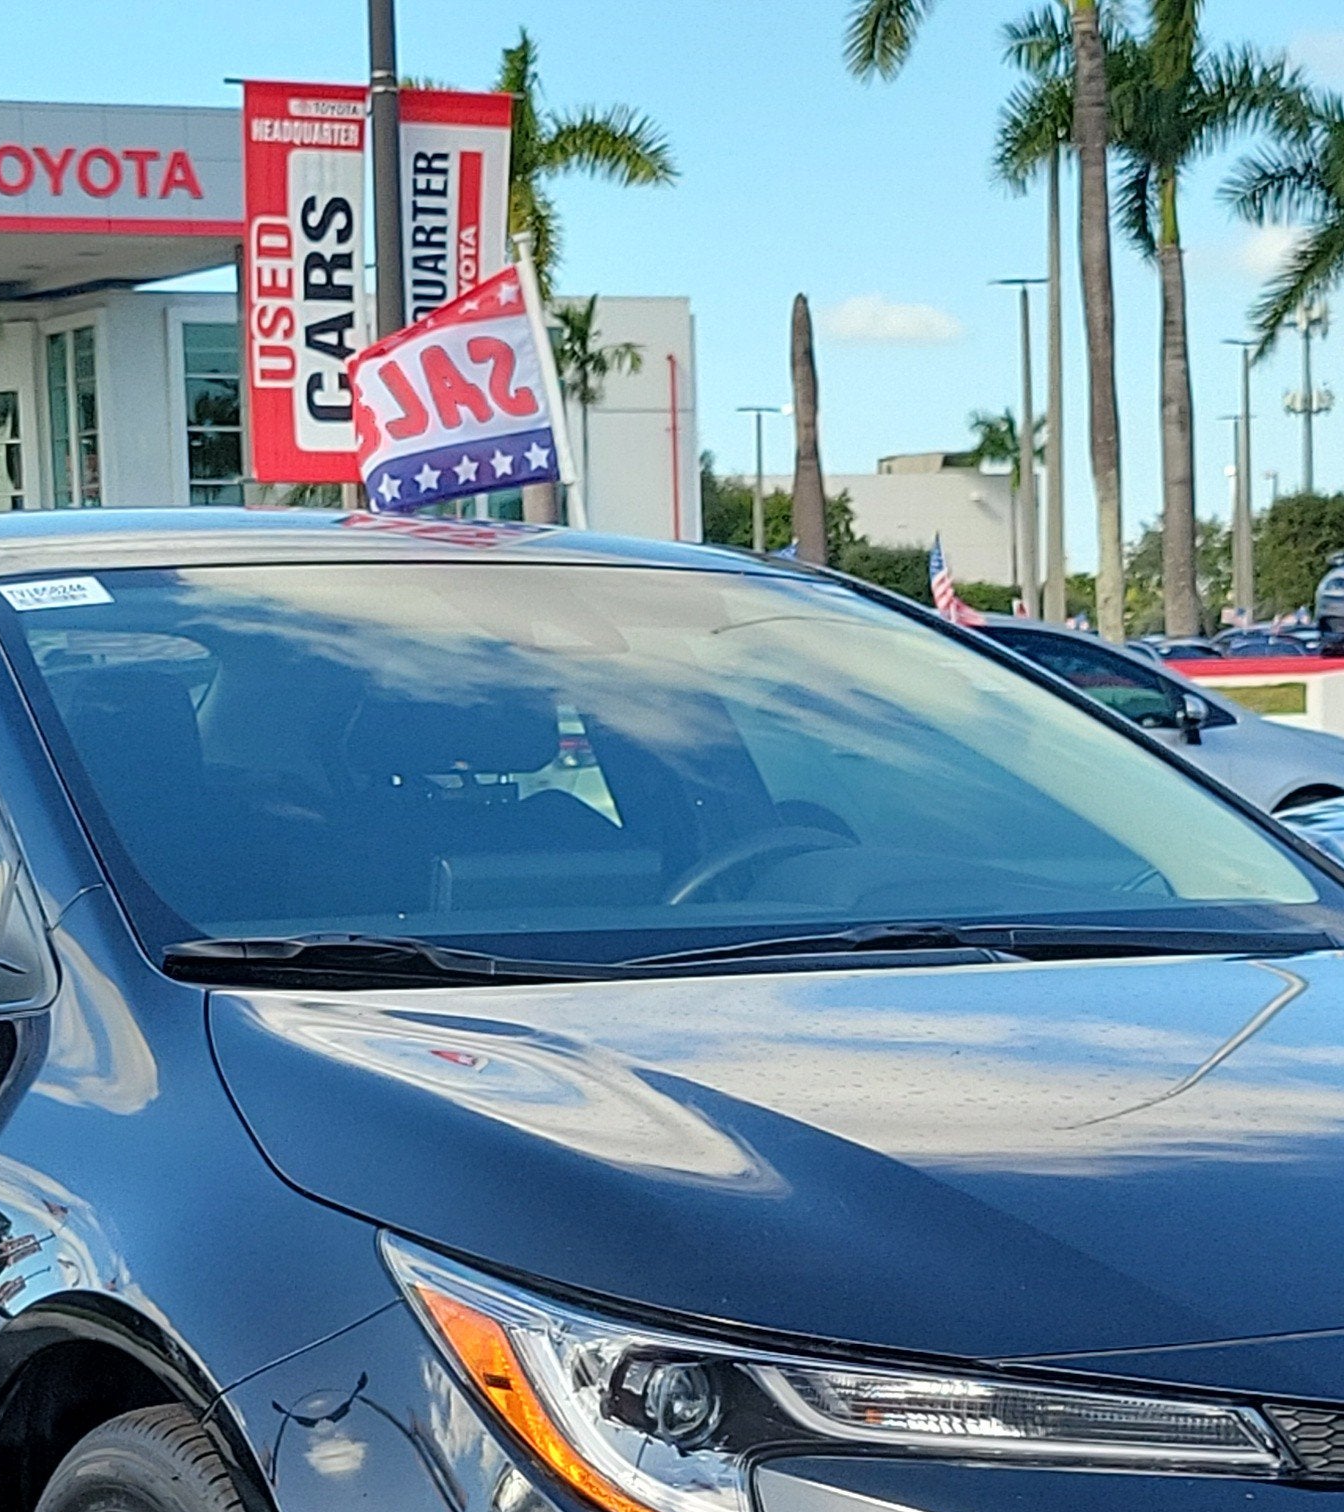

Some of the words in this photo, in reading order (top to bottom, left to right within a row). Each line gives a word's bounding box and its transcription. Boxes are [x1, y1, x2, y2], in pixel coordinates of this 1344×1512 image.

[251, 119, 359, 146] HEADQUARTER
[254, 218, 297, 384] USED
[300, 195, 356, 423] CARS
[411, 151, 450, 323] UARTER
